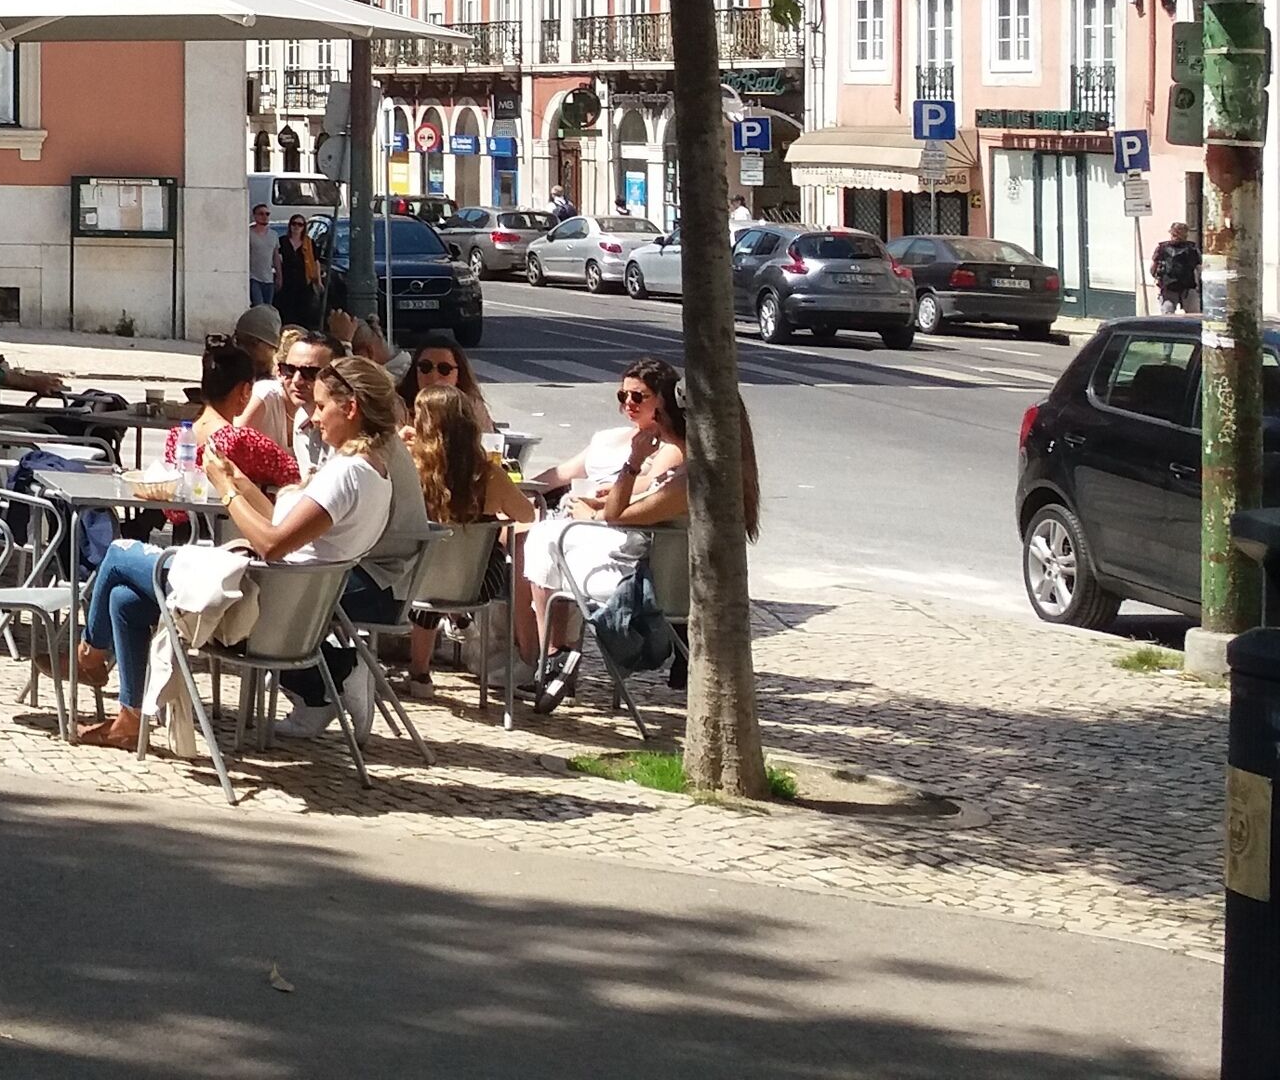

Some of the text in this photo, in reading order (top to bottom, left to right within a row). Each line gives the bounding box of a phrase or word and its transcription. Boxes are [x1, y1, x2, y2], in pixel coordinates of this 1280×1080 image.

[497, 100, 515, 110] MB
[741, 121, 762, 147] P
[922, 103, 947, 137] P
[1121, 135, 1142, 168] P
